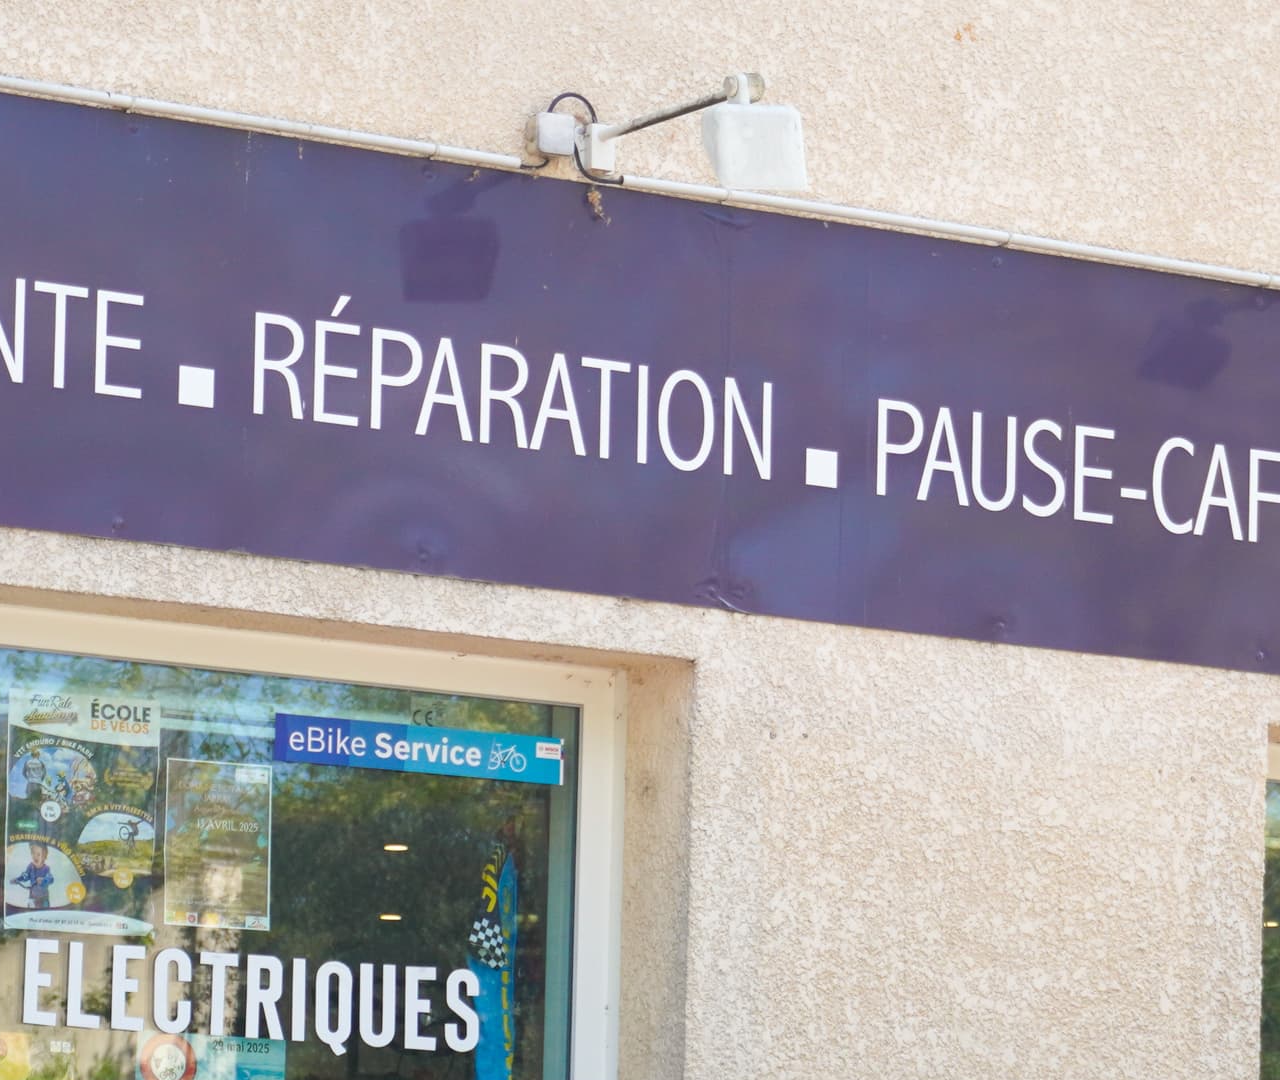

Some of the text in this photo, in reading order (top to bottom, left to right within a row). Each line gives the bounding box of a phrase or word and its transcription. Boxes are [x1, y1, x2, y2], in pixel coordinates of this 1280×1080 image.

[253, 295, 773, 480] RÉPARATION
[90, 698, 152, 723] ÉCOLE
[90, 719, 107, 731] DE
[288, 727, 482, 768] eBike Service
[239, 821, 259, 833] 2025
[21, 937, 481, 1056] ELECTRIQUES
[212, 1040, 270, 1054] 29 mai 2025
